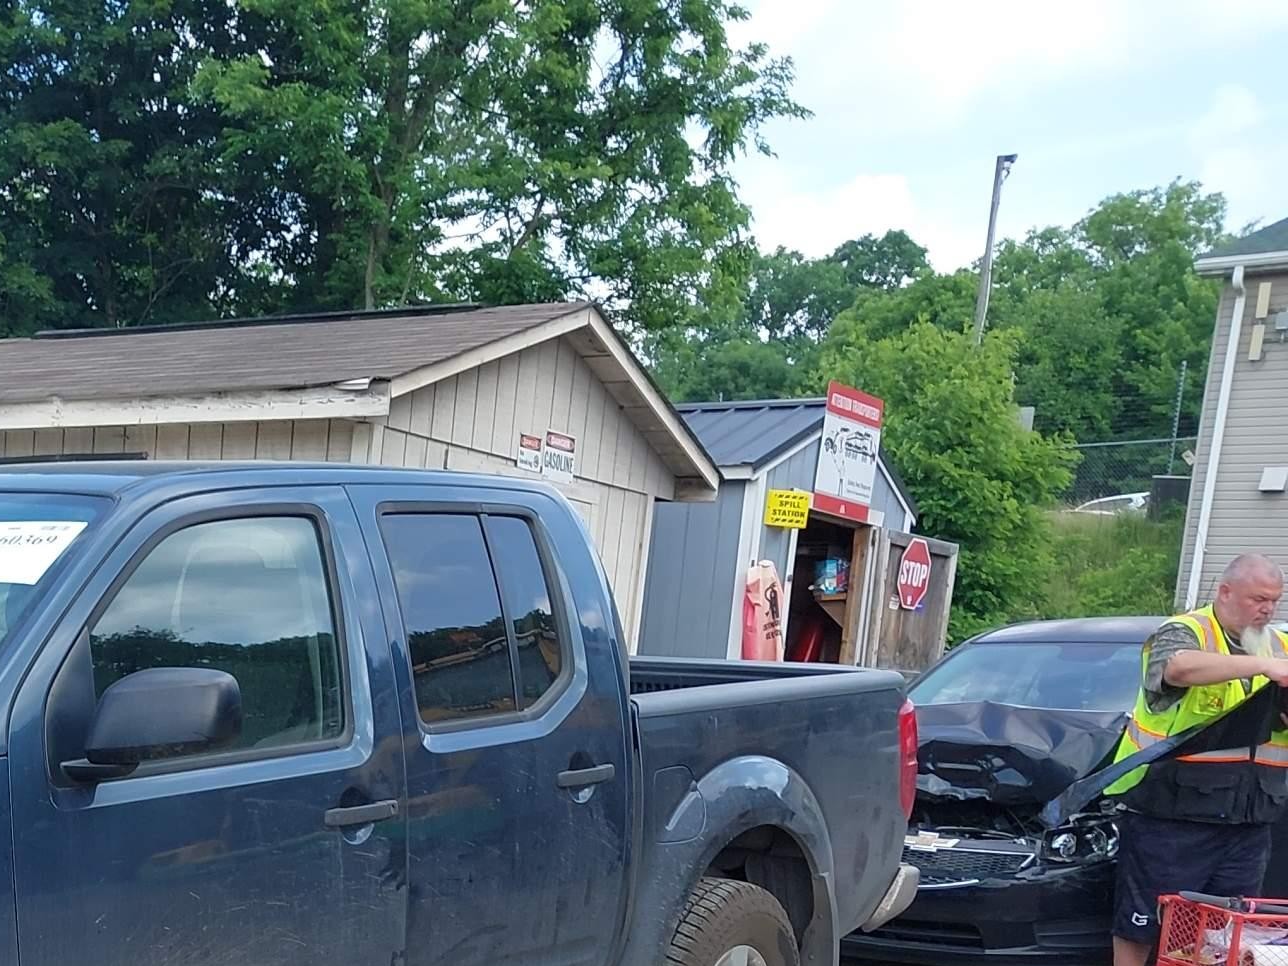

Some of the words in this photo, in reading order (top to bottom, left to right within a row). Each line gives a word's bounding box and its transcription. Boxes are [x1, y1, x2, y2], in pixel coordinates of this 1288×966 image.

[544, 450, 574, 473] GASOLINE
[779, 500, 801, 509] SPILL
[772, 509, 806, 518] STATION
[900, 559, 928, 588] STOP
